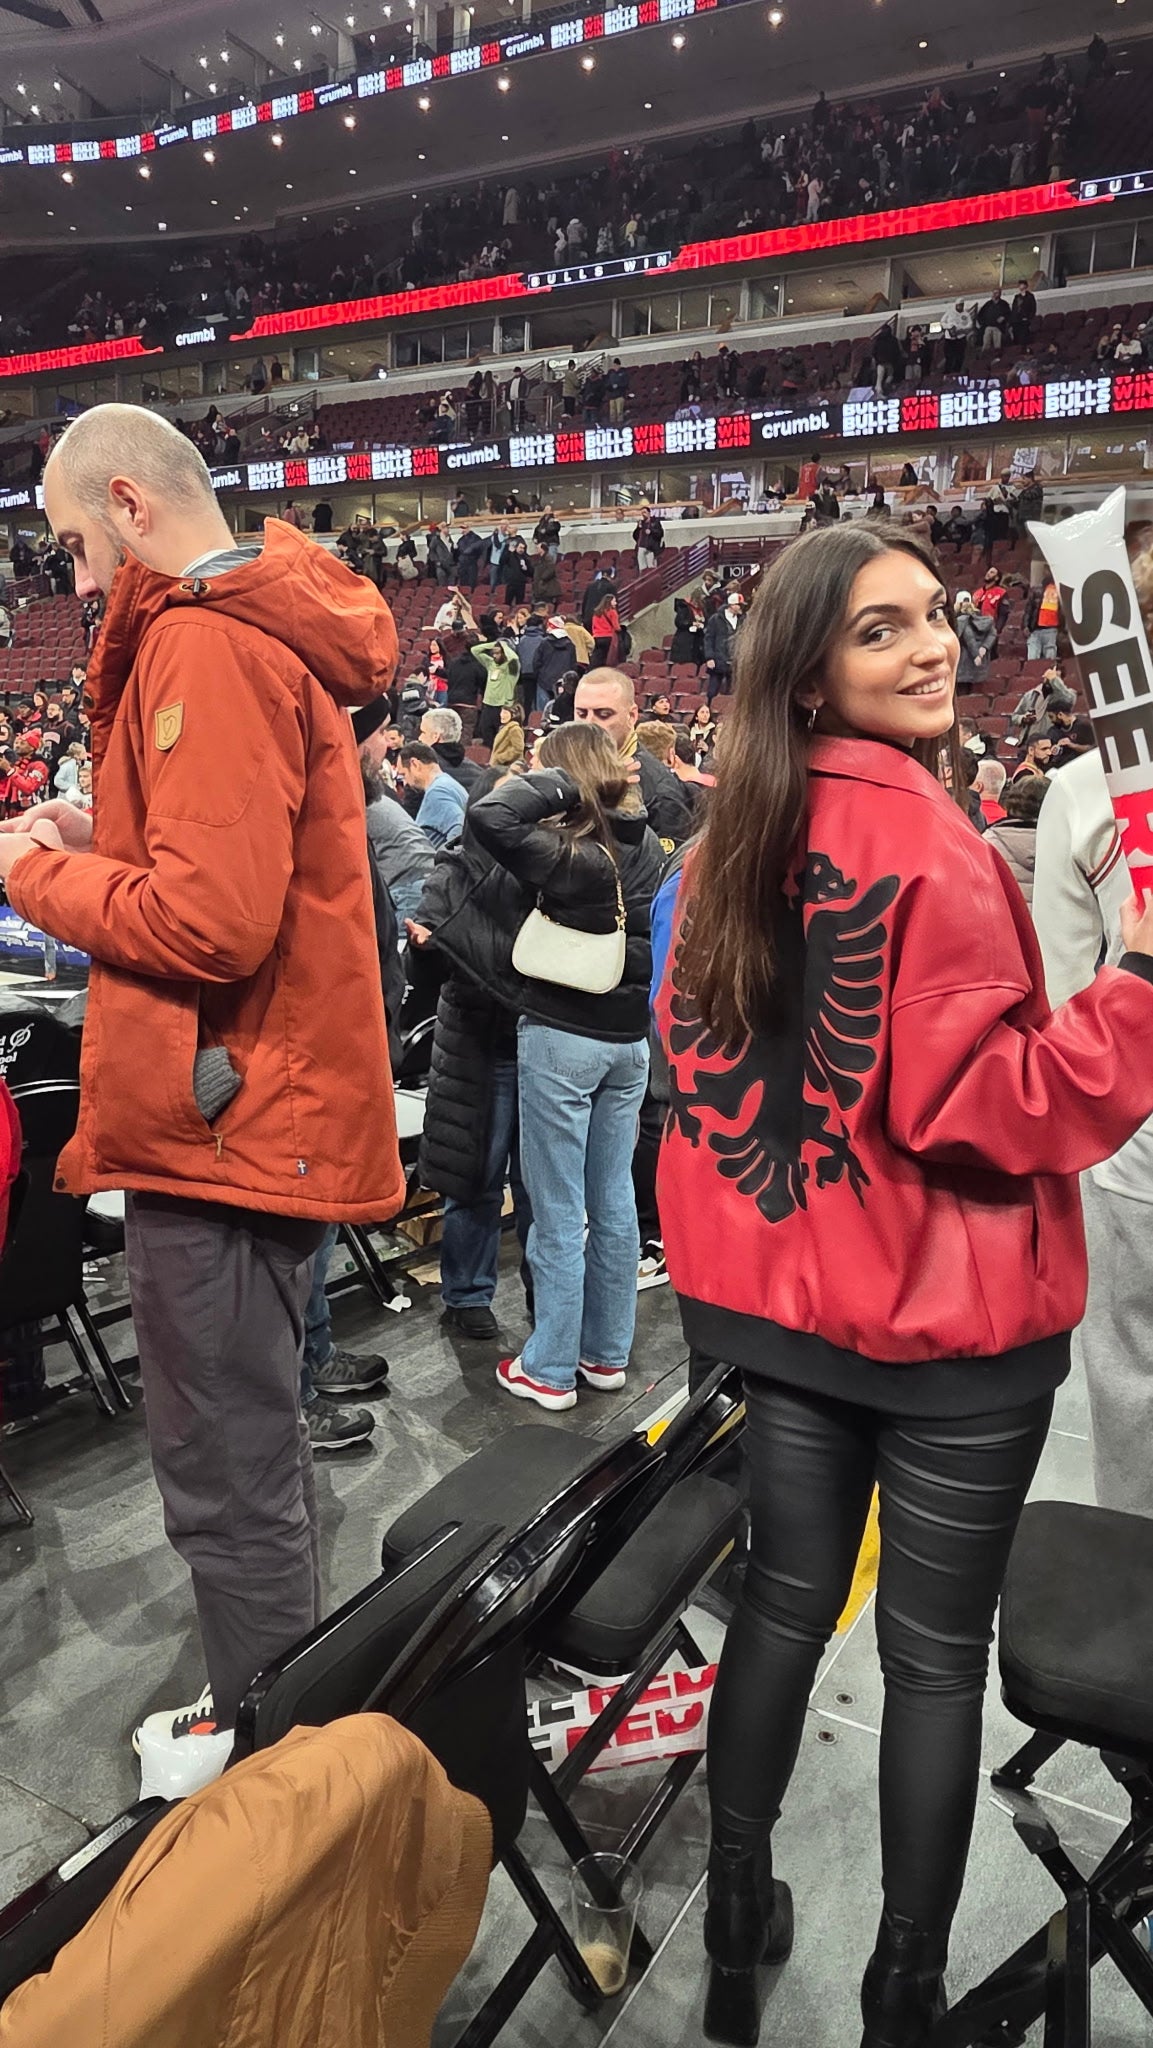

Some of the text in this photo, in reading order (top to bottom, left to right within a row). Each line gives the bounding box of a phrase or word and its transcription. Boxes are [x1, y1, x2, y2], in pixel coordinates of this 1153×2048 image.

[506, 33, 544, 57] crumbl
[319, 84, 352, 104] crumbl
[531, 254, 667, 287] BULLS WIN
[175, 327, 216, 347] crumbl
[940, 385, 1043, 414] BULLS WIN
[1045, 387, 1111, 412] BULLS
[762, 411, 829, 439] crumbl
[843, 402, 938, 432] BULLS WIN
[940, 399, 1043, 428] BULLS WIN
[585, 424, 664, 448] BULLS WIN
[665, 421, 750, 448] BULLS WIN
[447, 444, 500, 468] crumbl
[585, 436, 664, 460] BULLS WIN
[0, 490, 30, 508] rumbl
